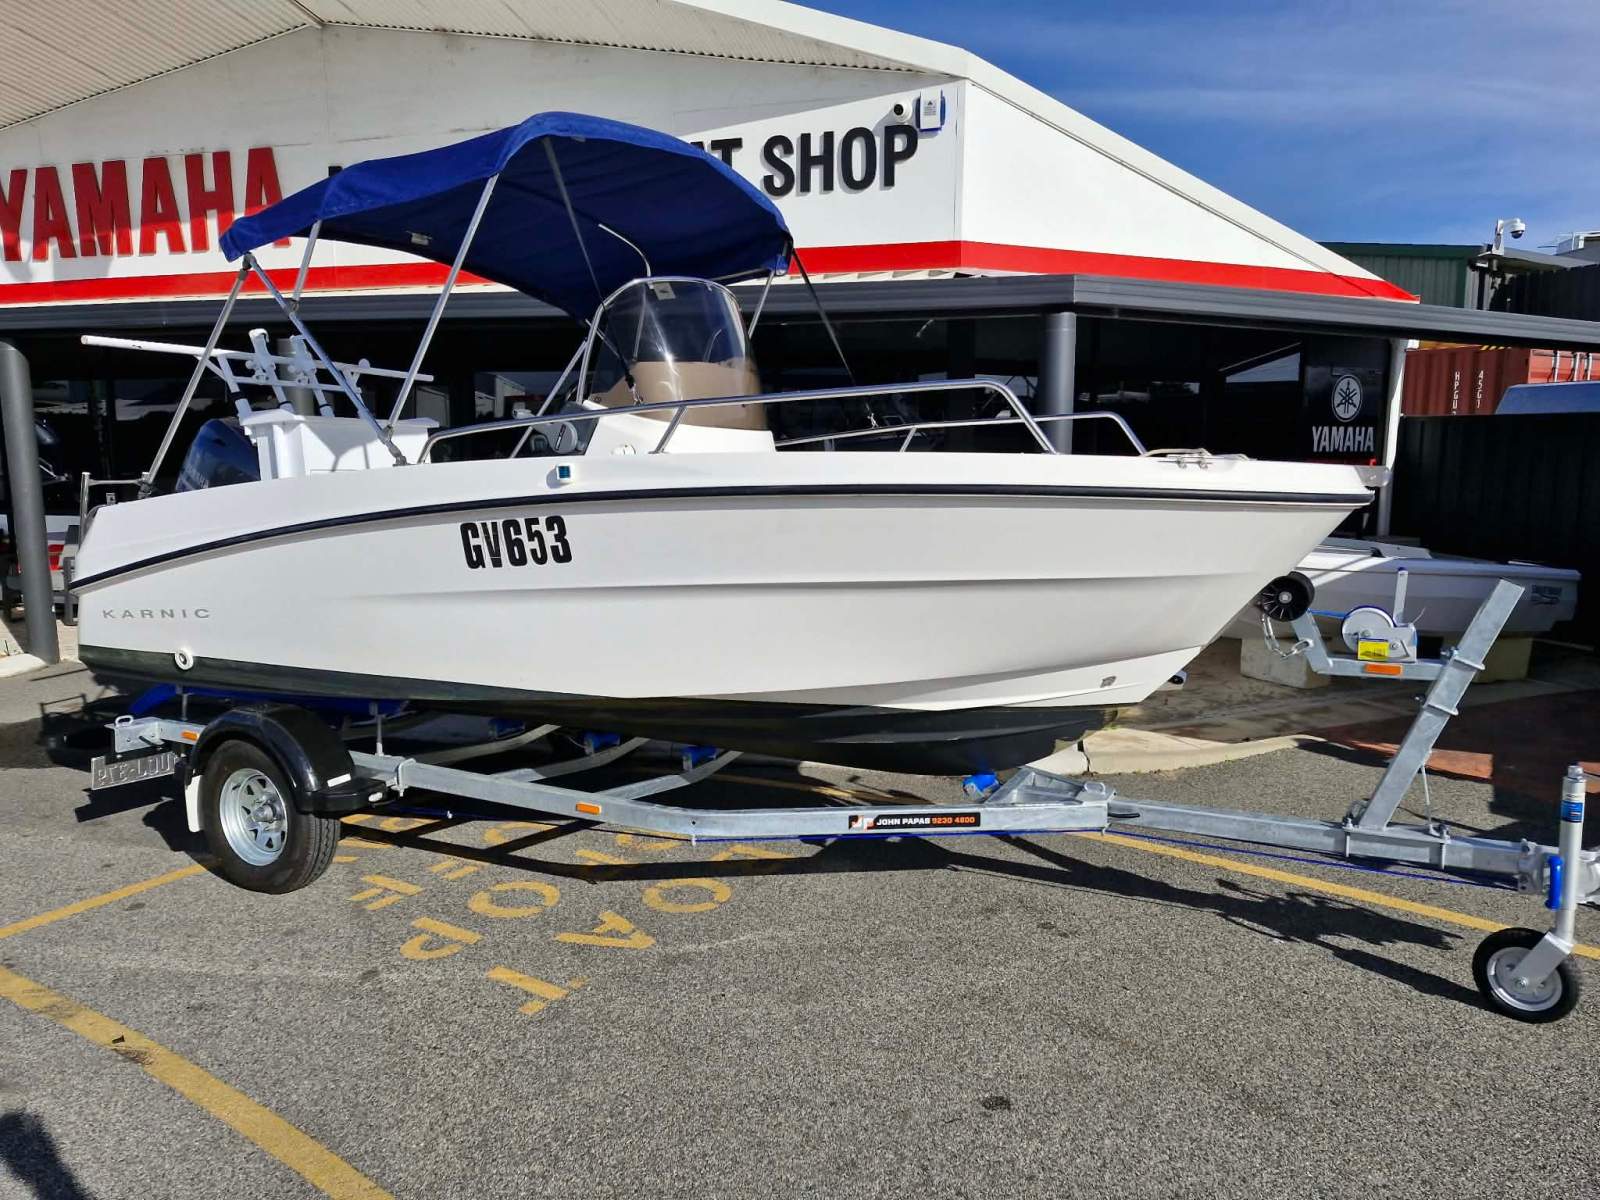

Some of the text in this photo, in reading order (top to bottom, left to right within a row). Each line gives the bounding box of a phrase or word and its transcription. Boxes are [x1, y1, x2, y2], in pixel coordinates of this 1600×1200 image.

[763, 124, 918, 197] SHOP
[0, 147, 292, 263] YAMAHA
[1312, 426, 1375, 453] YAMAHA
[459, 514, 573, 569] GV653
[102, 608, 211, 620] KARNIC
[876, 817, 901, 826] JOHN
[902, 816, 931, 825] PAPAS
[931, 816, 953, 825] 9230
[954, 815, 975, 824] 4800
